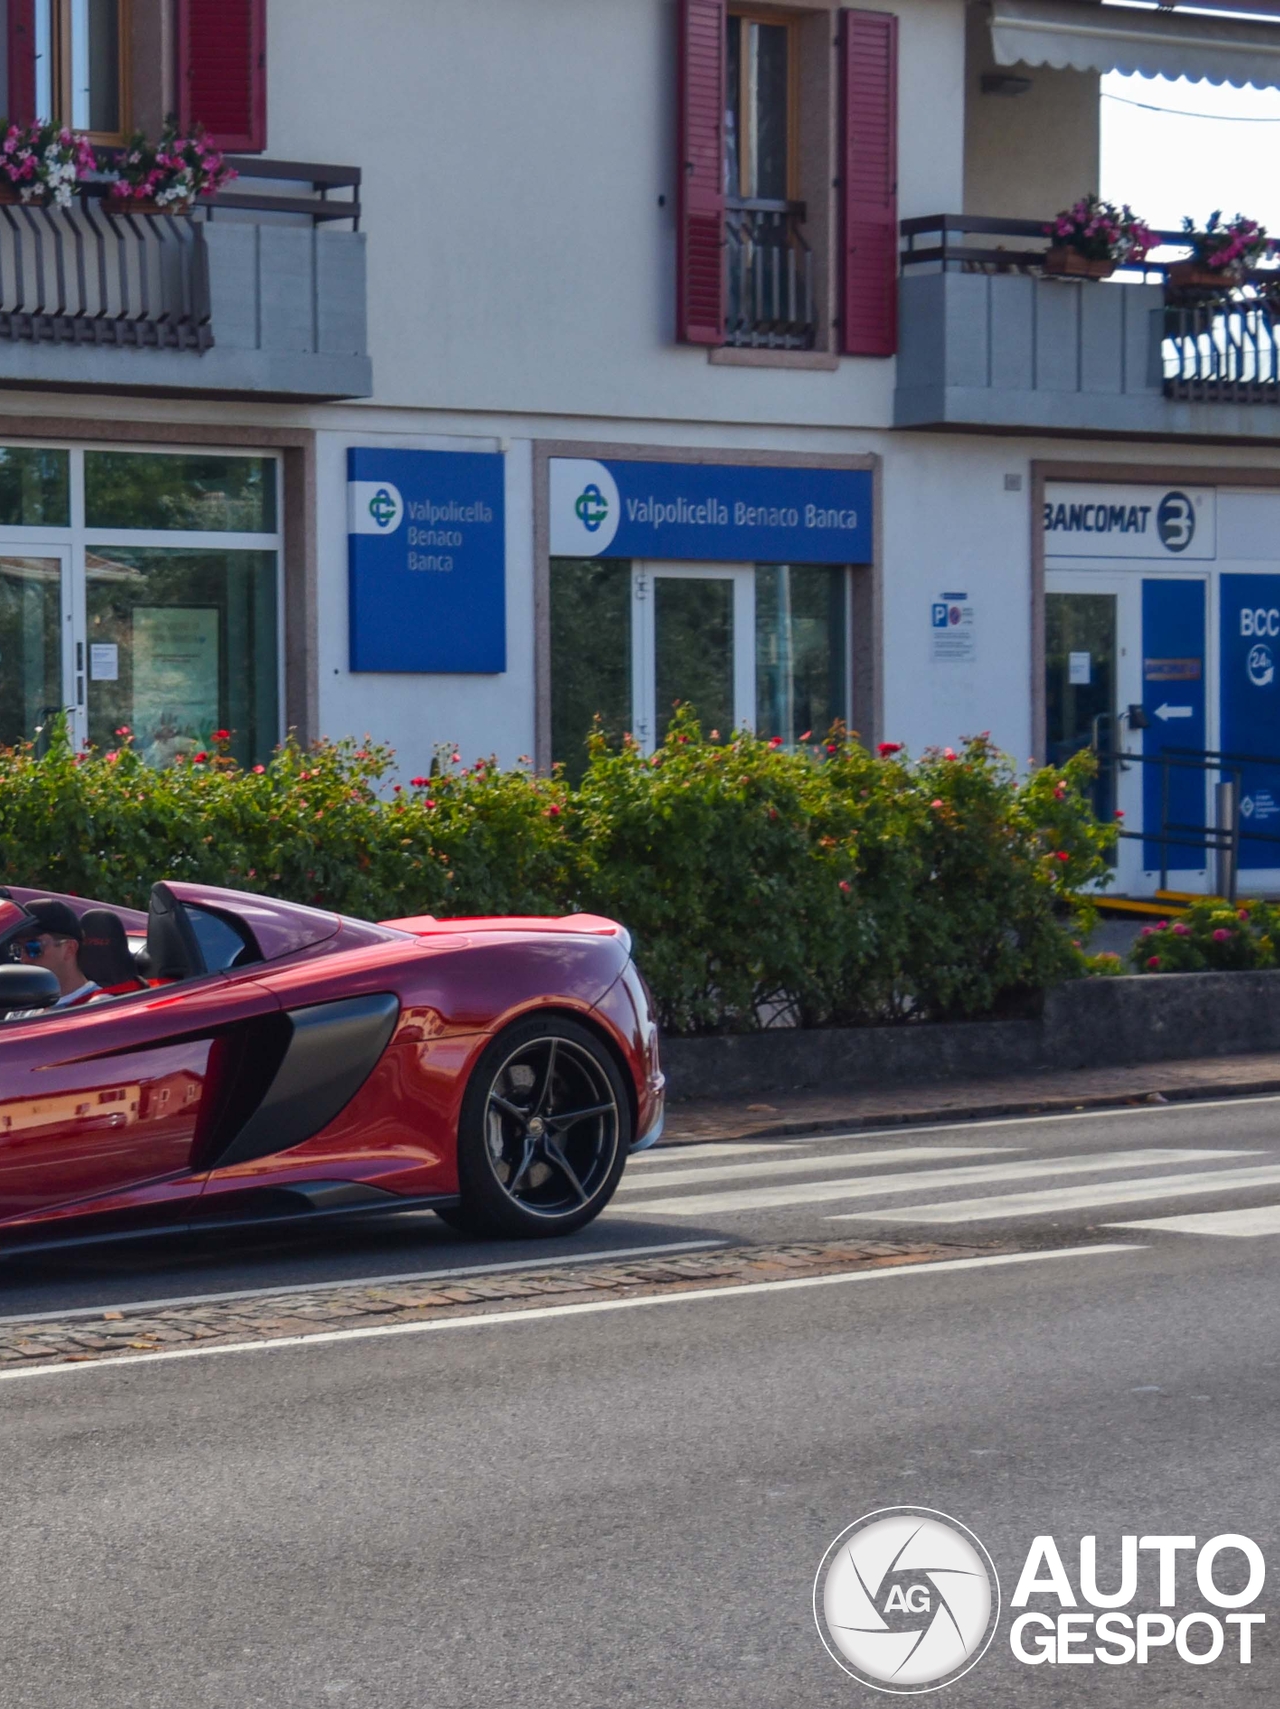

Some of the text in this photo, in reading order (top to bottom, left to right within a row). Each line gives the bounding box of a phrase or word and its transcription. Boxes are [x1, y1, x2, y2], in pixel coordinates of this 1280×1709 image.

[407, 499, 493, 526] Valpolicella
[626, 496, 858, 530] Valpolicella Benaco Banca
[407, 526, 462, 547] Benaco
[407, 550, 454, 572] Banca
[1240, 608, 1280, 637] BCC
